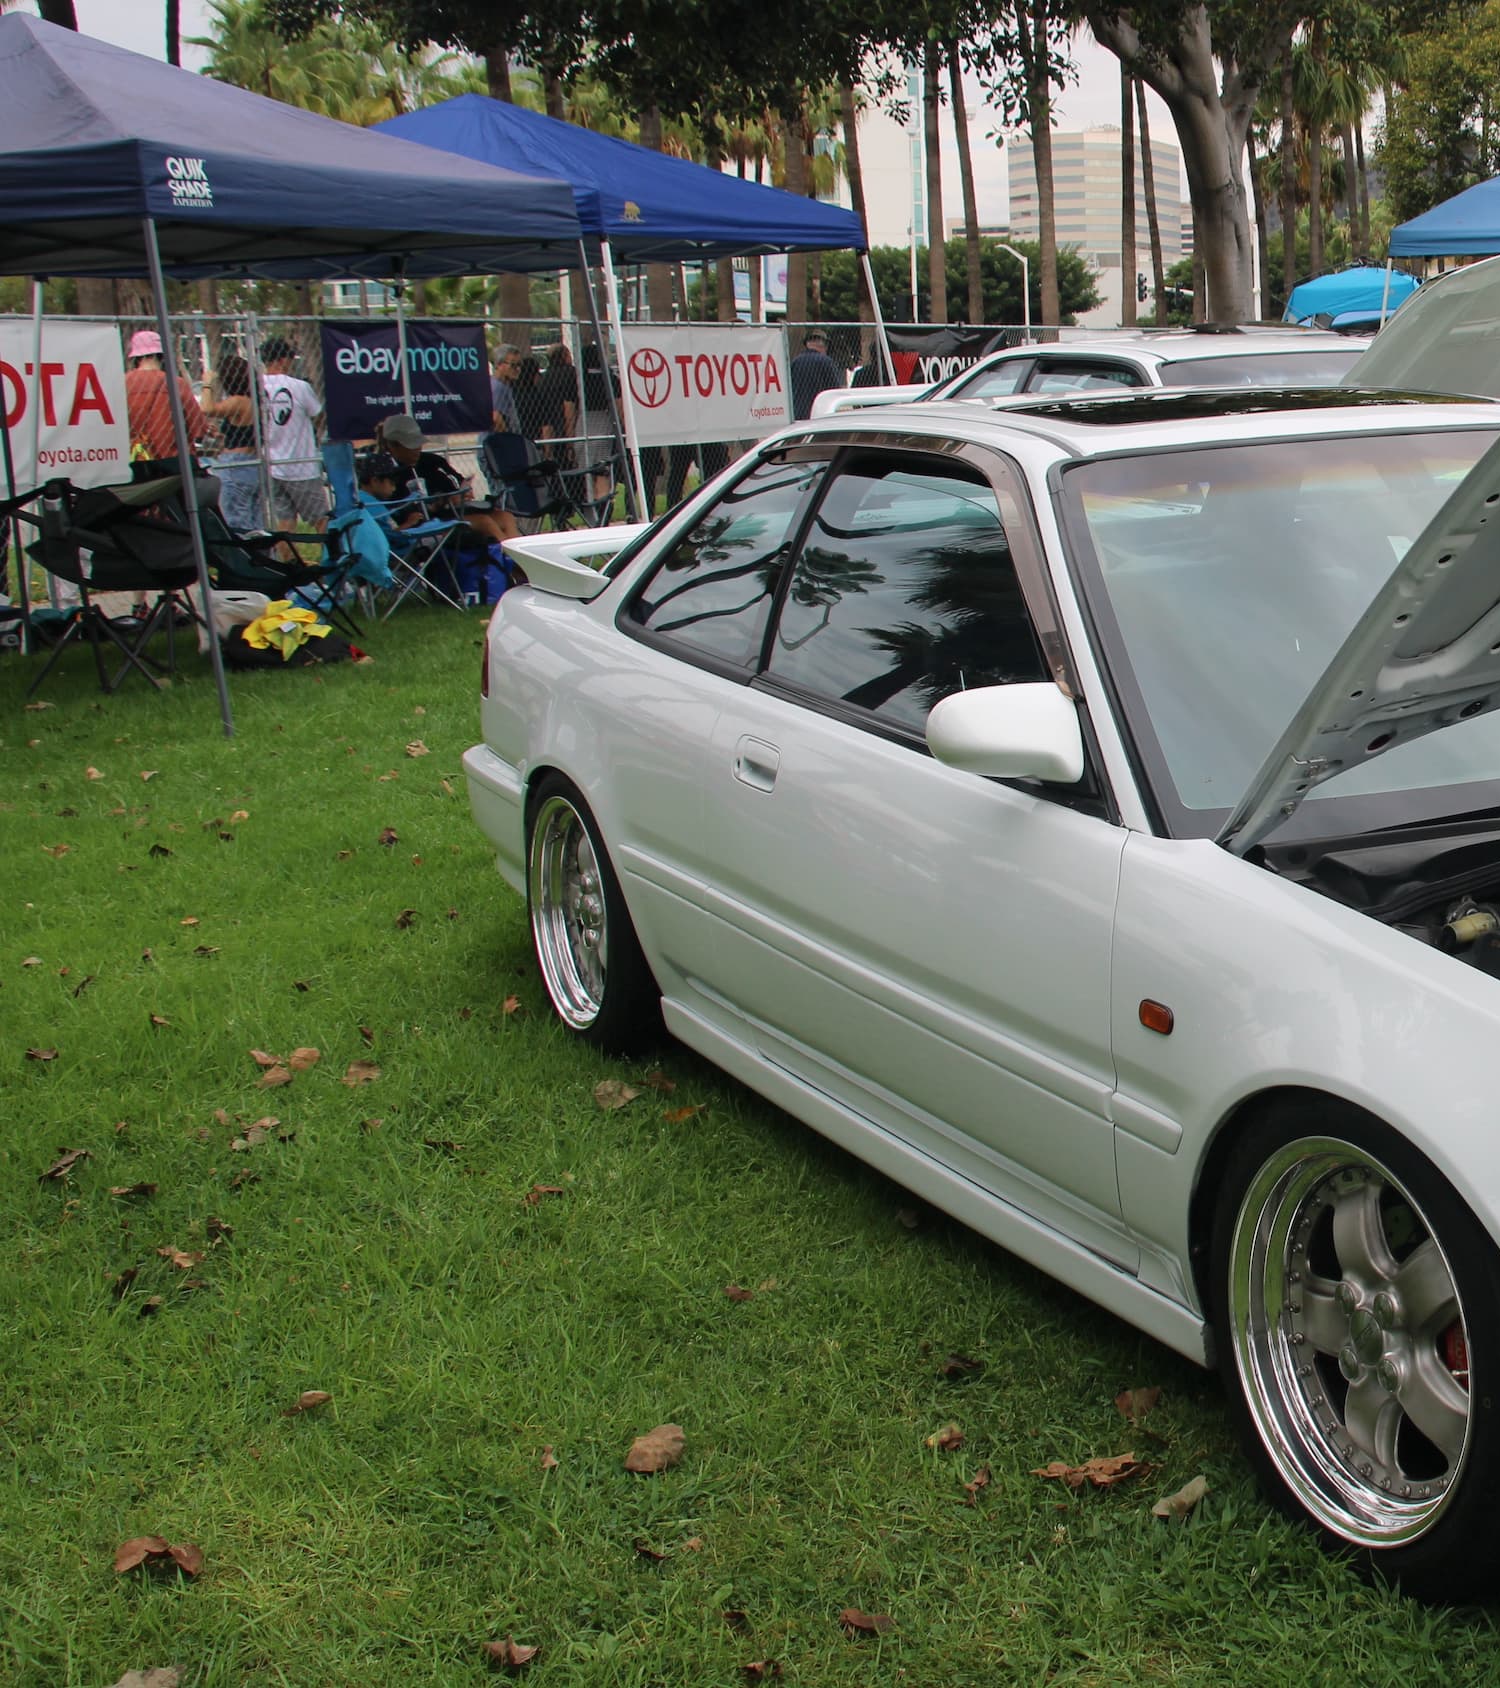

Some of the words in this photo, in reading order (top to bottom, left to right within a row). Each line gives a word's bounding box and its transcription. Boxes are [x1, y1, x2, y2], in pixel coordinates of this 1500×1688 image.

[166, 156, 208, 180] QUIK
[168, 180, 213, 199] SHADE
[336, 339, 402, 380] ebay
[406, 341, 479, 371] motors
[675, 353, 782, 398] TOYOTA
[750, 406, 785, 420] toyota.com
[37, 447, 118, 468] oyota.com
